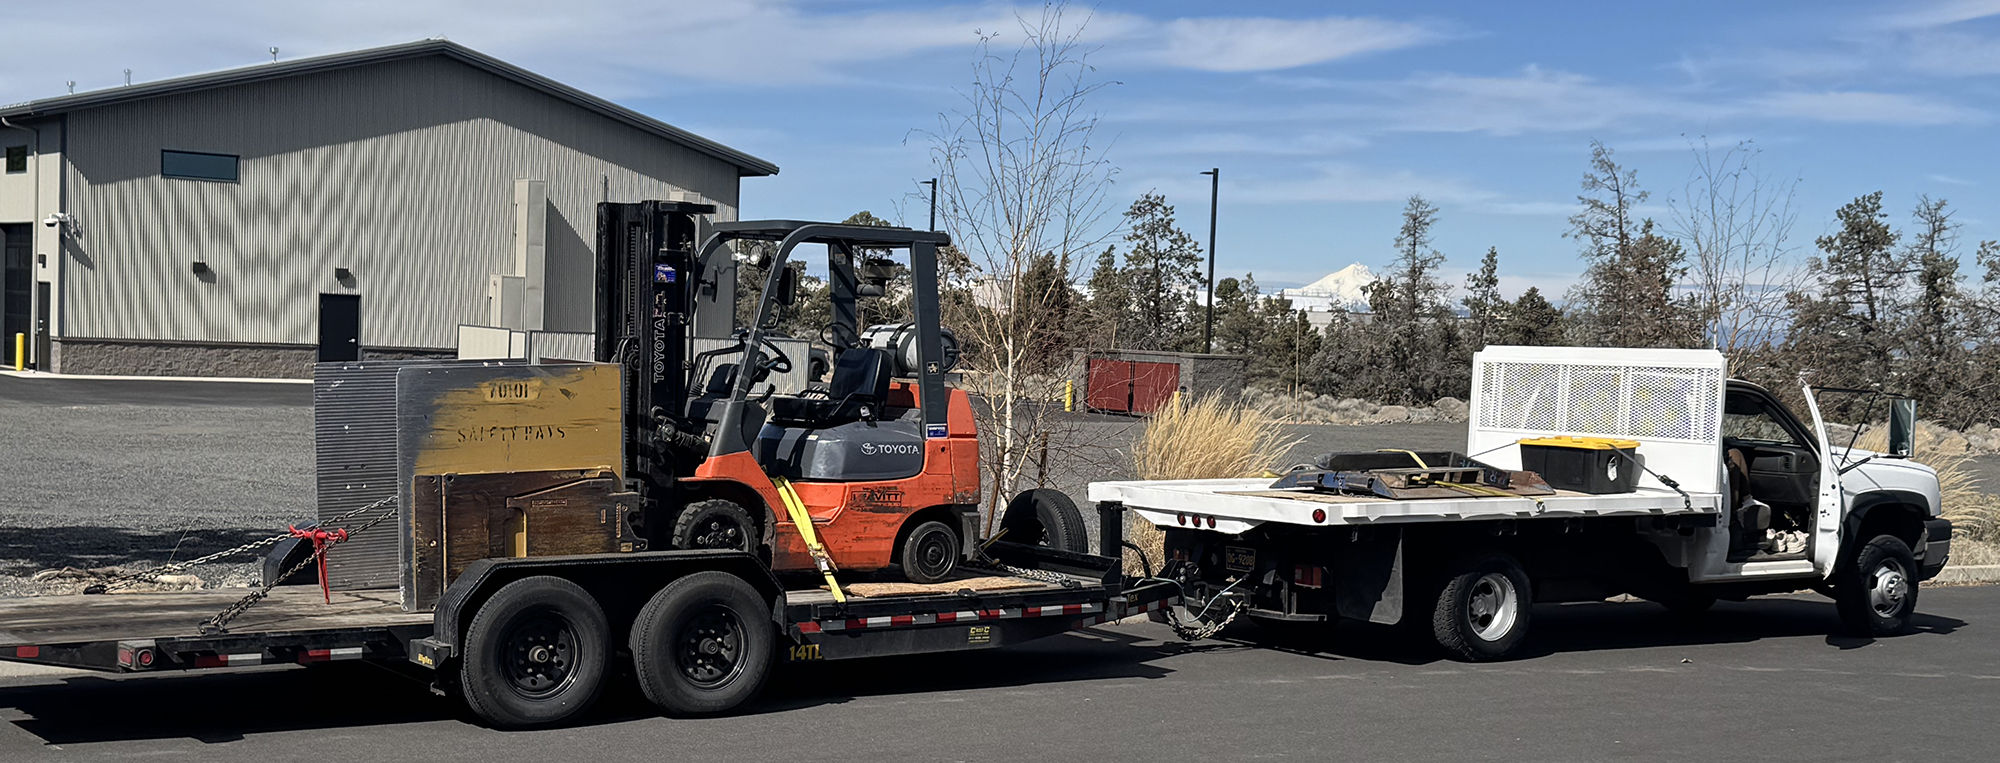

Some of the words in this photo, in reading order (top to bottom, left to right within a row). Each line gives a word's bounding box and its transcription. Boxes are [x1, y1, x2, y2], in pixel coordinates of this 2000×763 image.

[653, 319, 665, 383] TOYOTA
[878, 444, 919, 454] TOYOTA
[789, 644, 822, 660] 14TL
